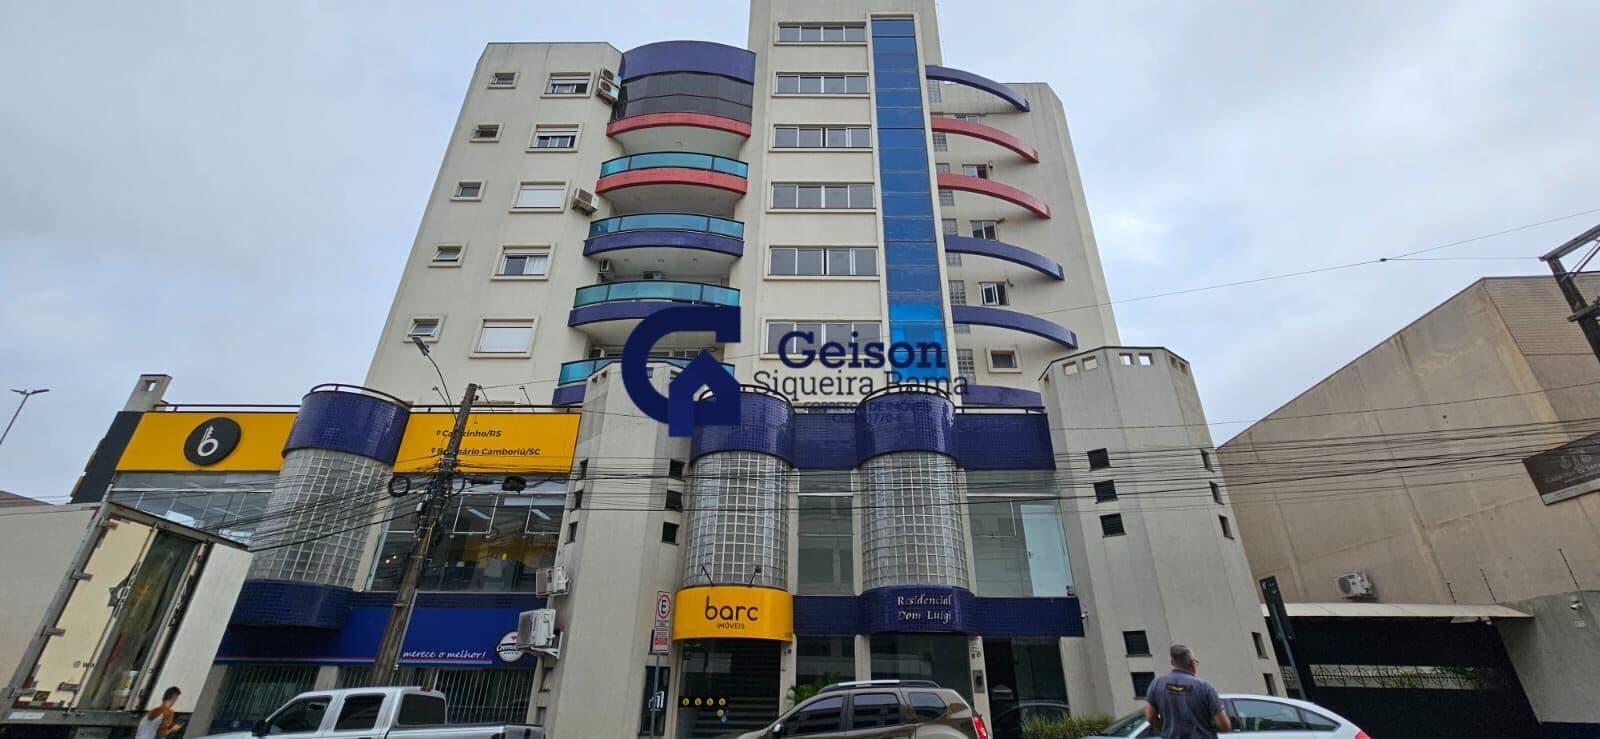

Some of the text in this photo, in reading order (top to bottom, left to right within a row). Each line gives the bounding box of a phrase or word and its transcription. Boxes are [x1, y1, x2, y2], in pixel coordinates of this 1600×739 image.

[481, 447, 541, 456] Camboriú/SC
[897, 593, 952, 606] Residencial
[661, 599, 667, 614] E
[705, 595, 758, 621] barc
[897, 610, 952, 624] Dom Luigi
[716, 621, 745, 630] IMÓVEIS
[447, 649, 486, 659] melhor!
